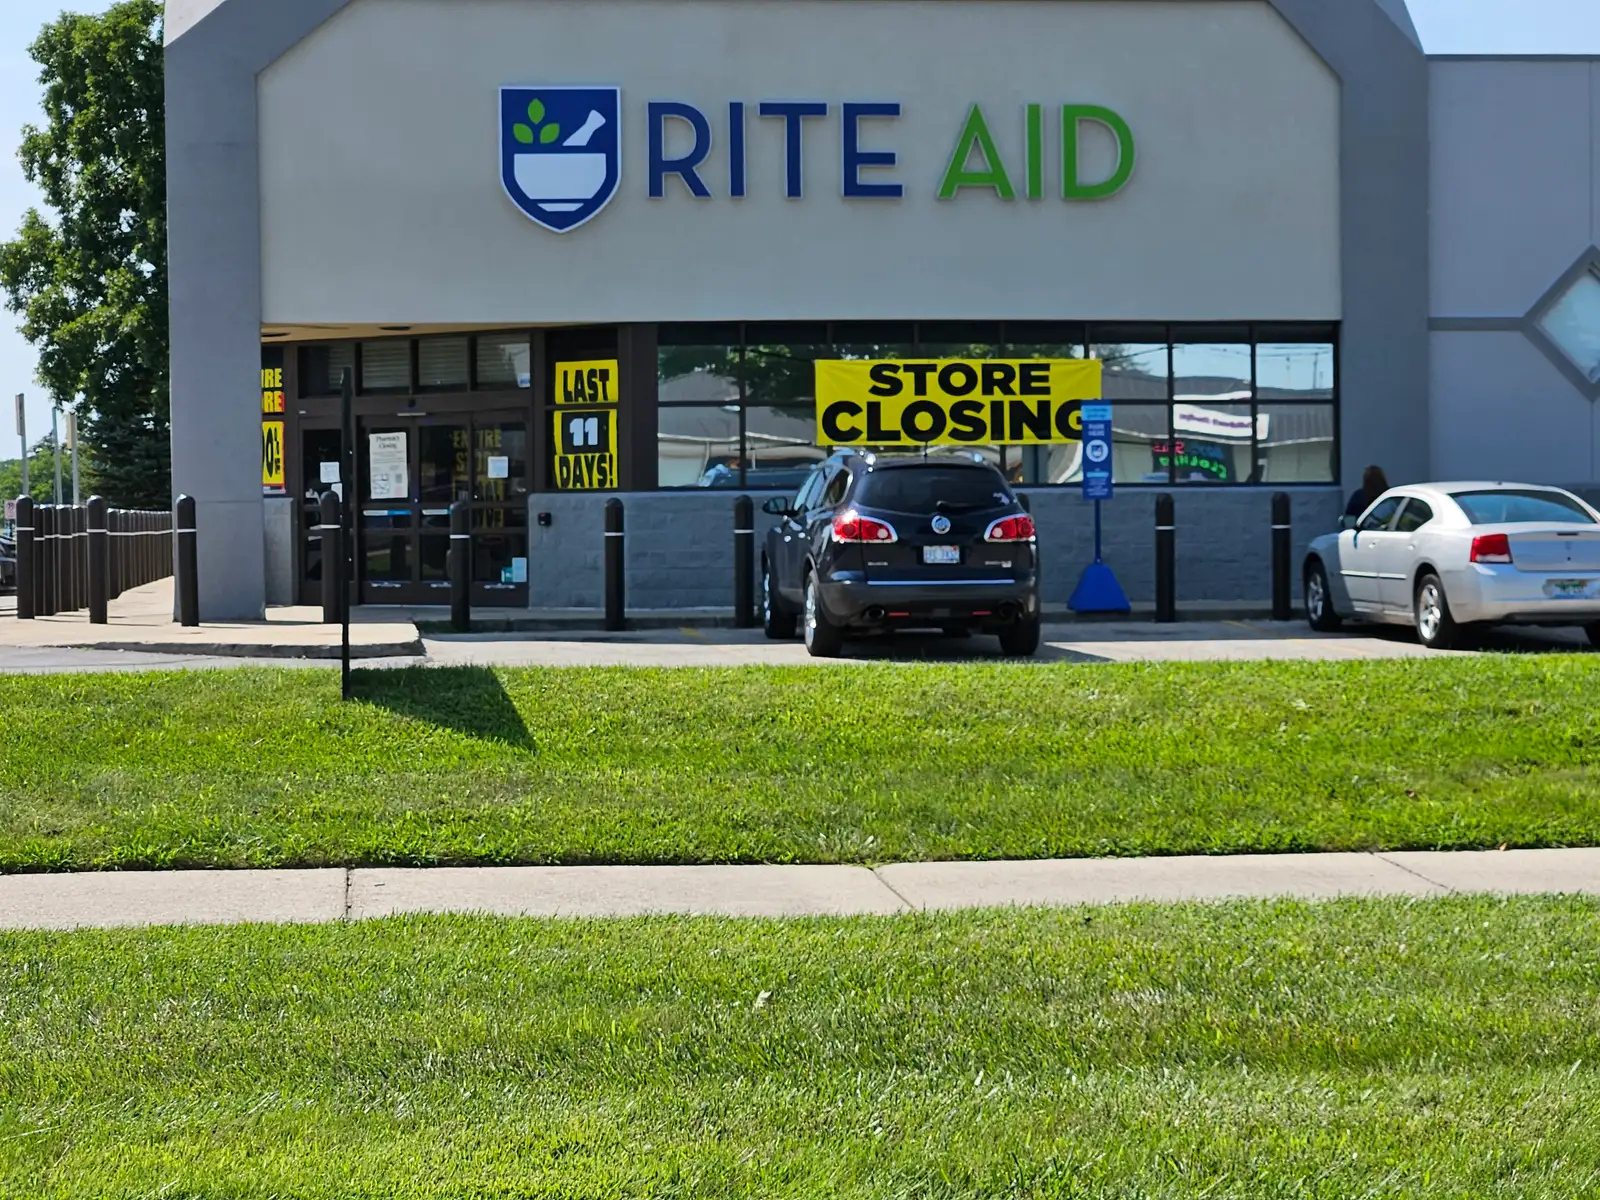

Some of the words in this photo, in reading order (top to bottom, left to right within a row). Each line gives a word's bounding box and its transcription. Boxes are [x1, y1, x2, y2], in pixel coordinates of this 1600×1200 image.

[648, 102, 904, 199] RITE
[937, 103, 1136, 199] AID
[563, 368, 610, 403] LAST
[868, 363, 1051, 397] STORE
[569, 417, 599, 447] 11
[822, 399, 1082, 443] CLOSING
[558, 453, 614, 488] DAYS!
